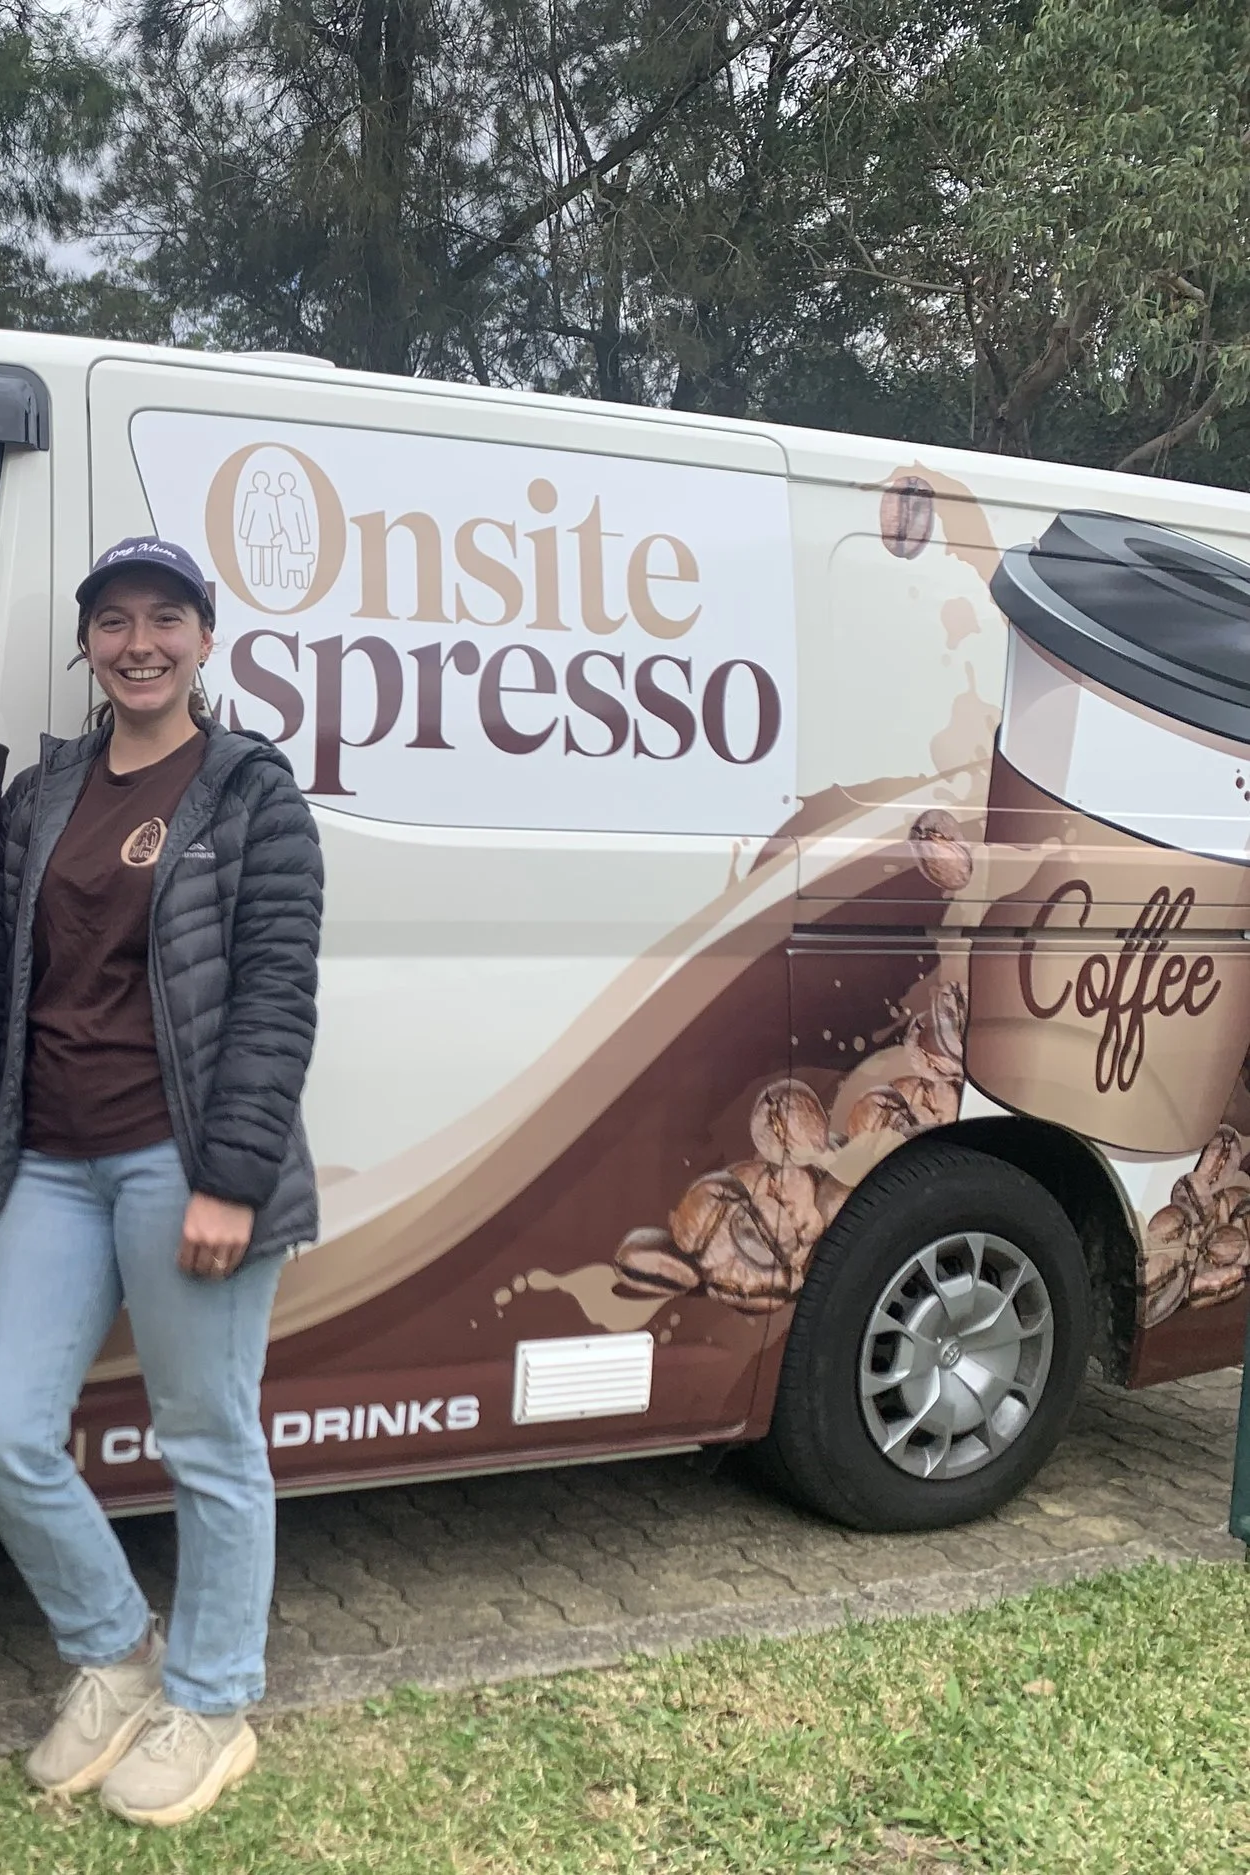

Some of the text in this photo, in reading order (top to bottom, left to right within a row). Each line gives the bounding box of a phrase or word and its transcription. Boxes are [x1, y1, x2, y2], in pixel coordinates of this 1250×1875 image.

[107, 542, 178, 563] Dog Mum
[205, 441, 702, 640] Onsite
[206, 582, 782, 797] spresso
[1018, 879, 1221, 1093] Coffee
[272, 1395, 481, 1448] DRINKS
